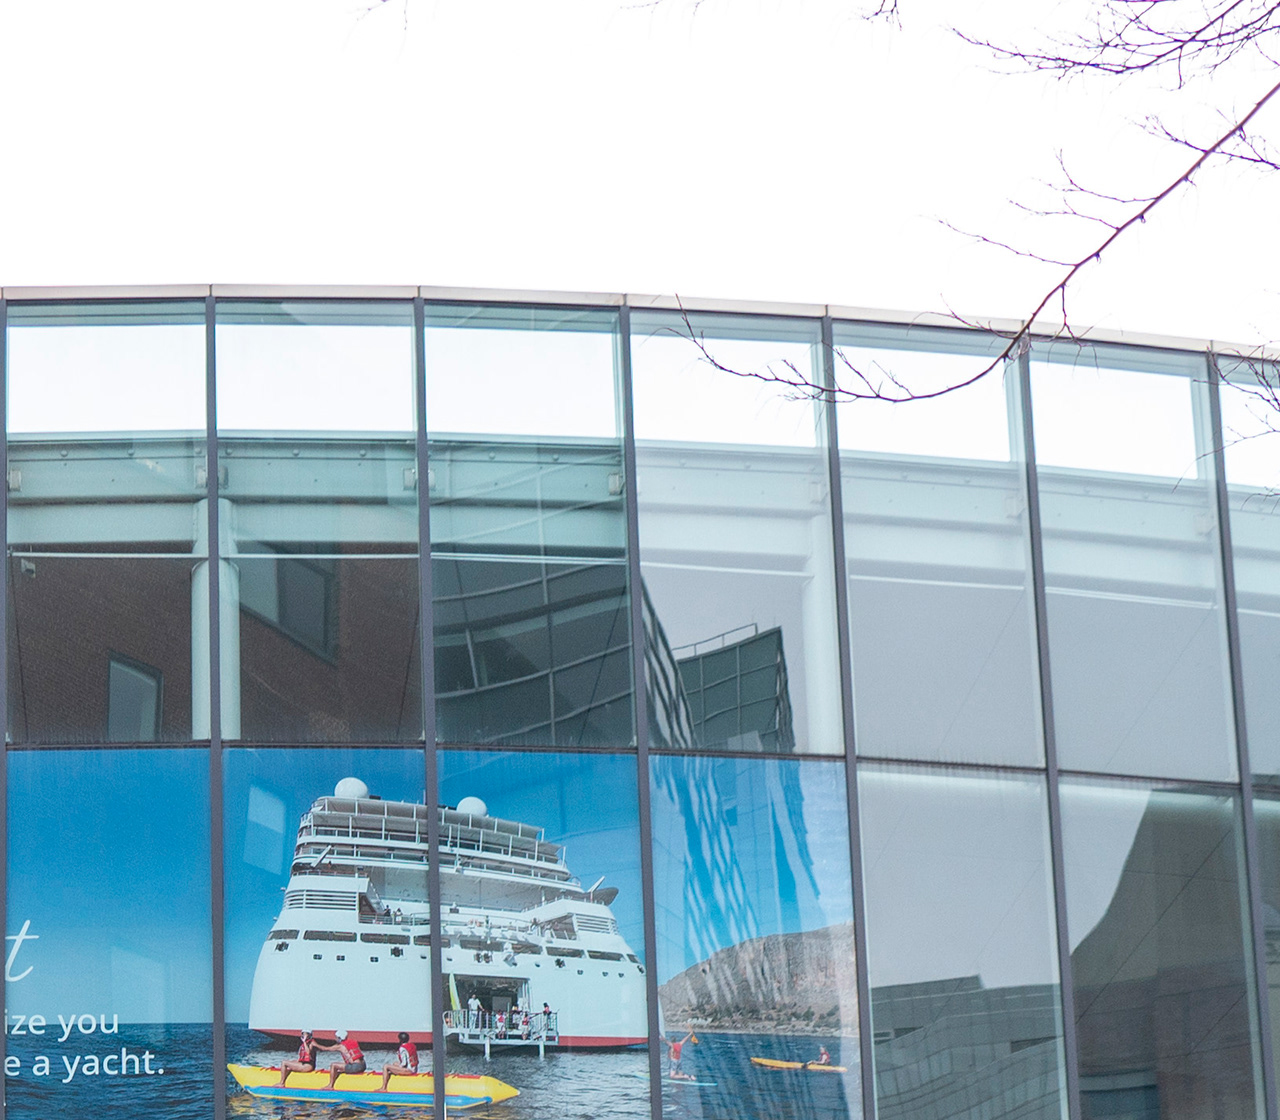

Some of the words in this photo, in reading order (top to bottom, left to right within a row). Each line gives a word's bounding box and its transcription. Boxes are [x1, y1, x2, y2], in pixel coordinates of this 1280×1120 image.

[58, 1012, 119, 1042] you
[32, 1053, 51, 1076] a
[62, 1046, 165, 1083] yacht.
